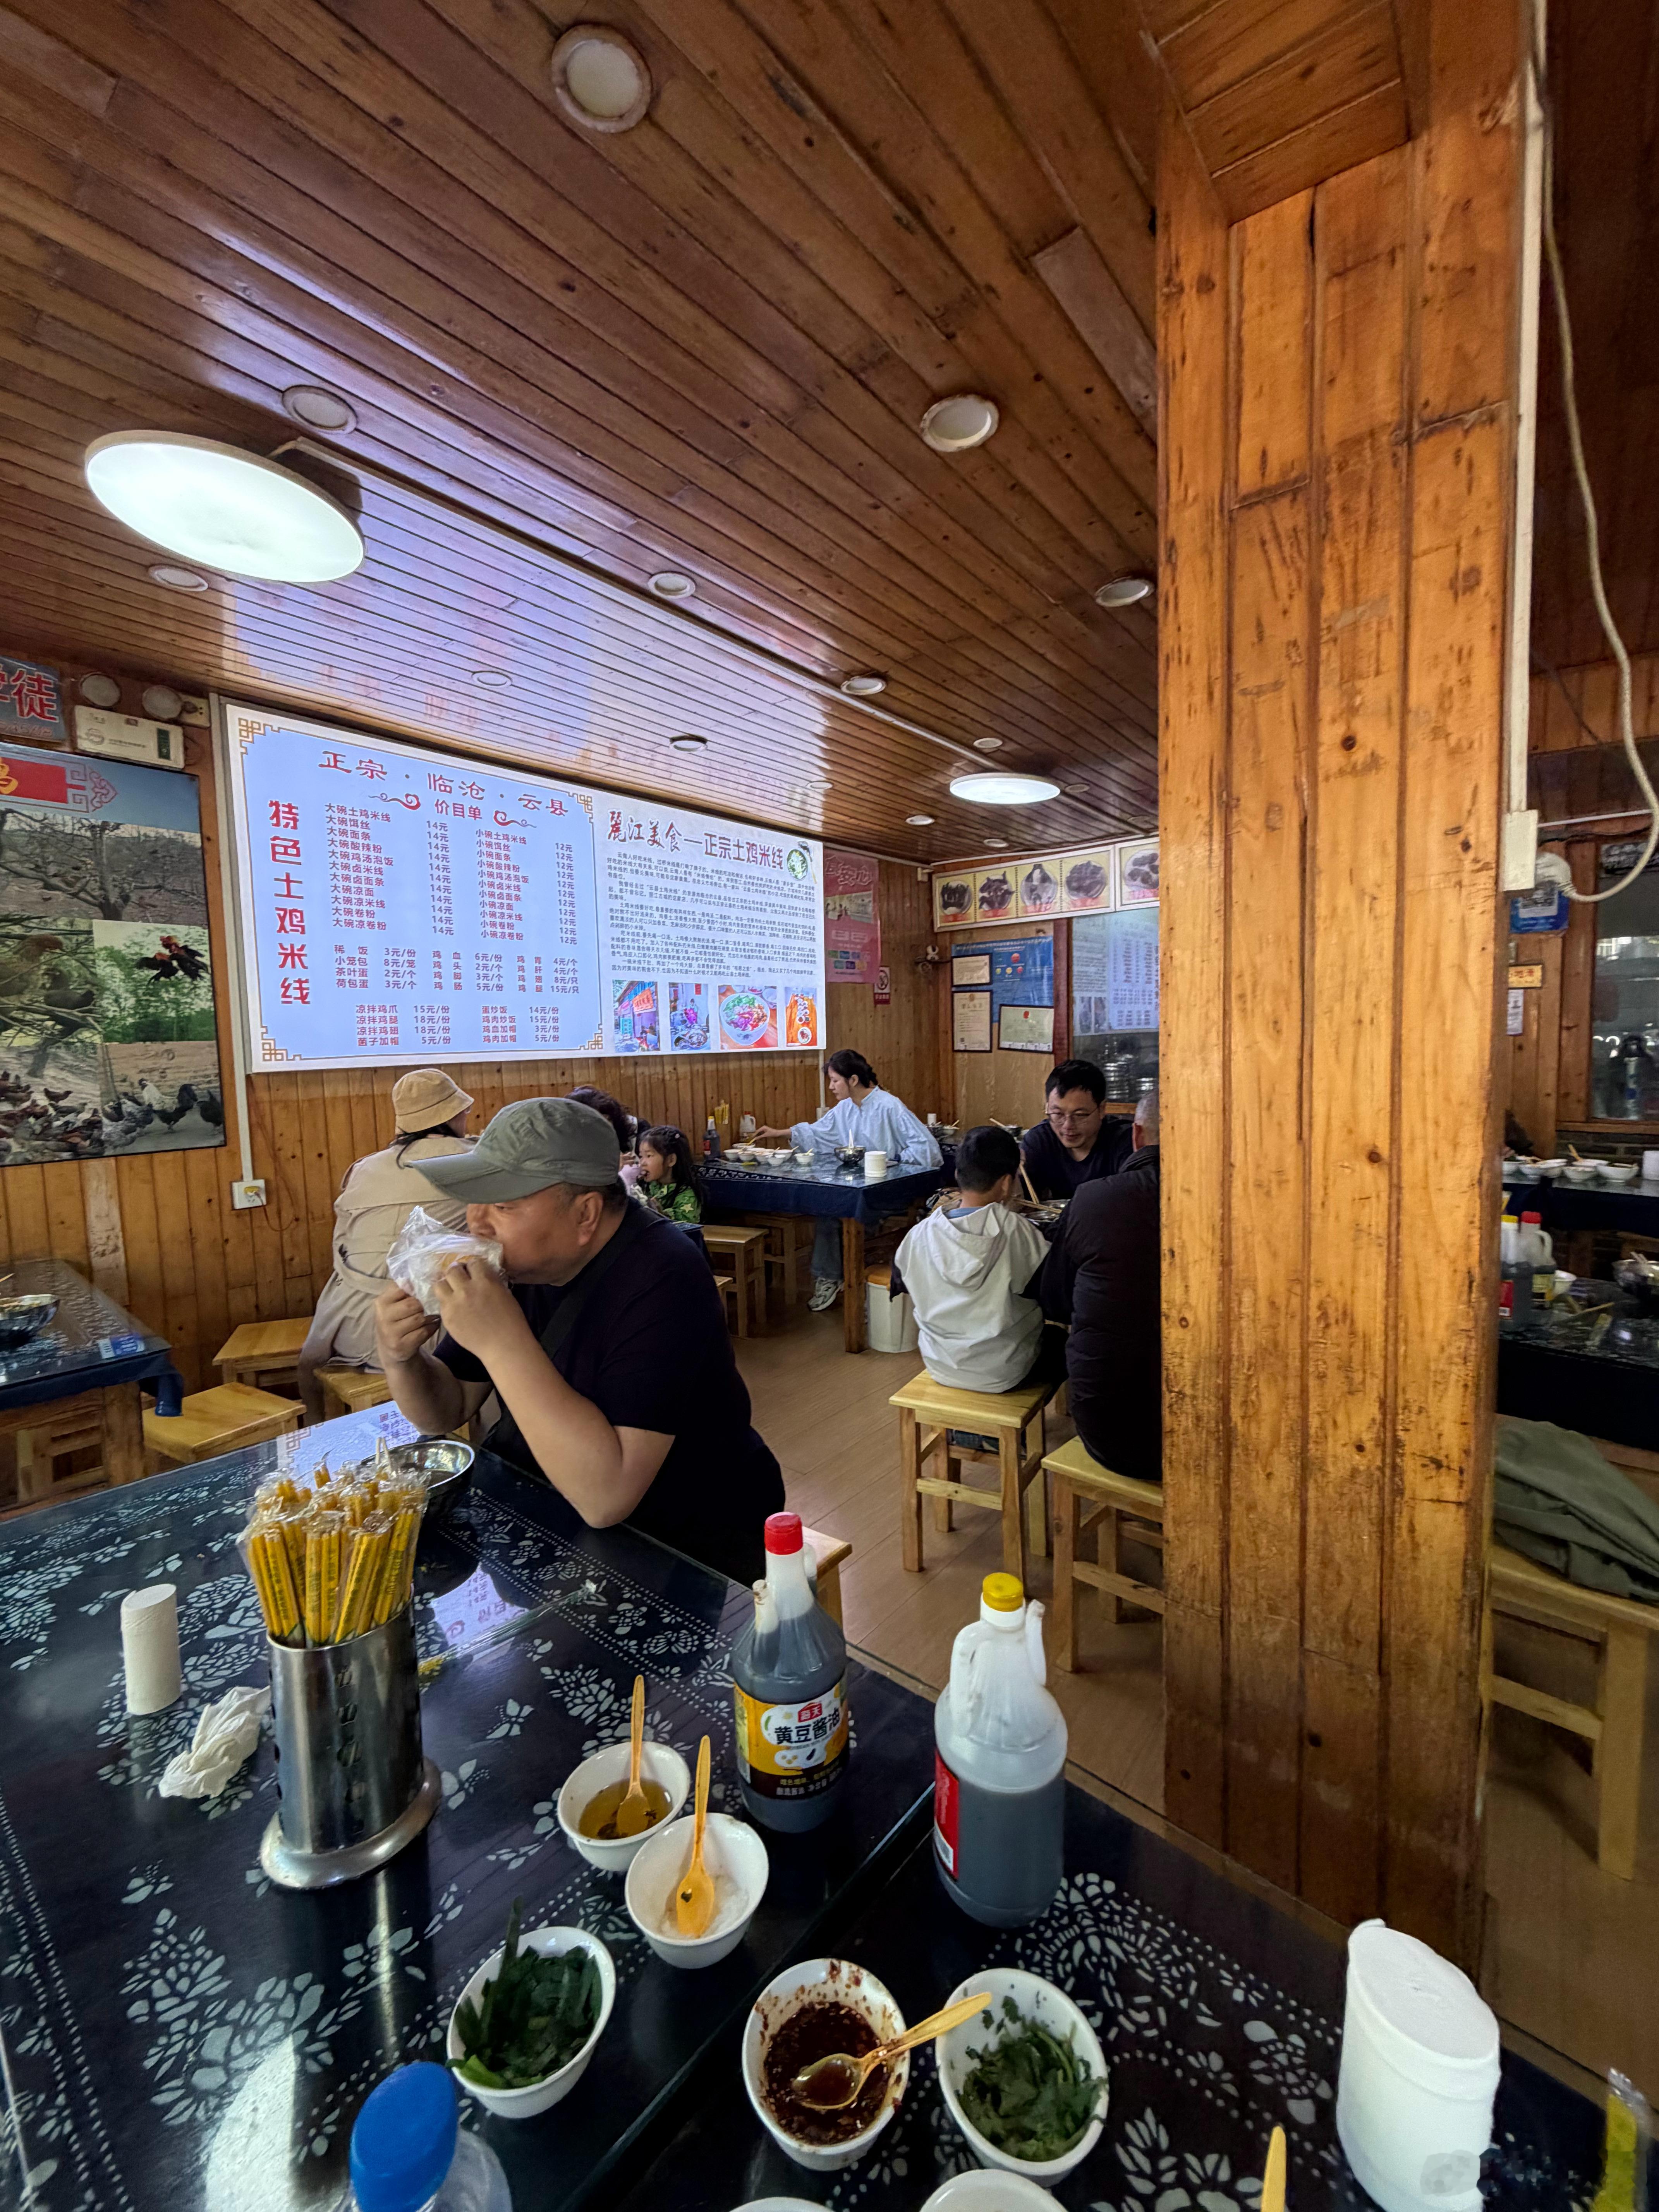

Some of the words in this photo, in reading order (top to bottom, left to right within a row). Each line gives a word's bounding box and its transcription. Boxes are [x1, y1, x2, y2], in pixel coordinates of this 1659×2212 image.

[0, 665, 59, 723] 徒
[325, 803, 390, 822] 大碗土鸡米线
[427, 820, 448, 831] 14元
[434, 799, 482, 820] 价目单
[326, 815, 371, 830] 大碗饵丝
[427, 831, 448, 842] 14元
[326, 826, 371, 841] 大碗面条
[428, 842, 449, 852] 14元
[476, 829, 527, 845] 小碗土鸡米线
[555, 843, 572, 852] 12元
[328, 838, 382, 854] 大碗酸辣粉
[429, 853, 450, 863] 14元
[476, 839, 511, 852] 小碗饵丝
[556, 852, 573, 862] 12元
[477, 849, 511, 861] 小碗面条
[556, 862, 574, 871] 12元
[328, 849, 393, 866] 大碗鸡汤泡饭
[429, 863, 450, 873] 14元
[477, 859, 520, 872] 小碗酸辣粉
[557, 871, 574, 880] 12元
[329, 860, 383, 876] 大碗卤米线
[430, 874, 451, 884] 14元
[478, 869, 529, 884] 小碗鸡汤泡饭
[557, 880, 574, 890] 12元
[330, 872, 384, 886] 大碗卤面条
[430, 884, 452, 894] 14元
[478, 879, 521, 892] 小碗卤米线
[558, 890, 575, 899] 12元
[268, 800, 310, 1005] 特色土鸡米线
[330, 884, 374, 896] 大碗凉面
[431, 895, 452, 904] 14元
[479, 890, 522, 902] 小碗卤面条
[558, 899, 575, 908] 12元
[331, 895, 385, 908] 大碗凉米线
[431, 905, 453, 915] 14元
[479, 900, 514, 911] 小碗凉面
[559, 908, 576, 917] 12元
[332, 906, 375, 919] 大碗卷粉
[432, 915, 453, 925] 14元
[480, 910, 522, 921] 小碗凉米线
[559, 918, 576, 926] 12元
[333, 918, 386, 930] 大碗凉卷粉
[433, 926, 454, 935] 14元
[481, 920, 514, 930] 小碗卷粉
[560, 927, 577, 936] 12元
[481, 930, 523, 940] 小碗凉卷粉
[560, 937, 577, 945] 12元
[335, 956, 368, 966] 小笼包
[384, 959, 416, 968] 8元/笼
[385, 948, 416, 957] 3元/份
[475, 953, 502, 962] 6元/份
[335, 967, 368, 977] 茶叶蛋
[385, 969, 416, 979] 2元/个
[476, 963, 503, 972] 2元/个
[336, 979, 368, 988] 荷包蛋
[385, 980, 417, 989] 3元/个
[476, 973, 503, 982] 3元/个
[476, 983, 503, 992] 5元/份
[356, 1005, 398, 1013] 凉拌鸡爪
[414, 1005, 450, 1014] 15元/份
[482, 1006, 507, 1014] 蛋炒饭
[356, 1015, 398, 1024] 凉拌鸡腿
[414, 1016, 450, 1024] 18元/份
[357, 1026, 398, 1035] 凉拌鸡翅
[415, 1026, 450, 1034] 18元/份
[422, 1036, 451, 1044] 5元/份
[775, 1707, 840, 1745] 黄豆酱油
